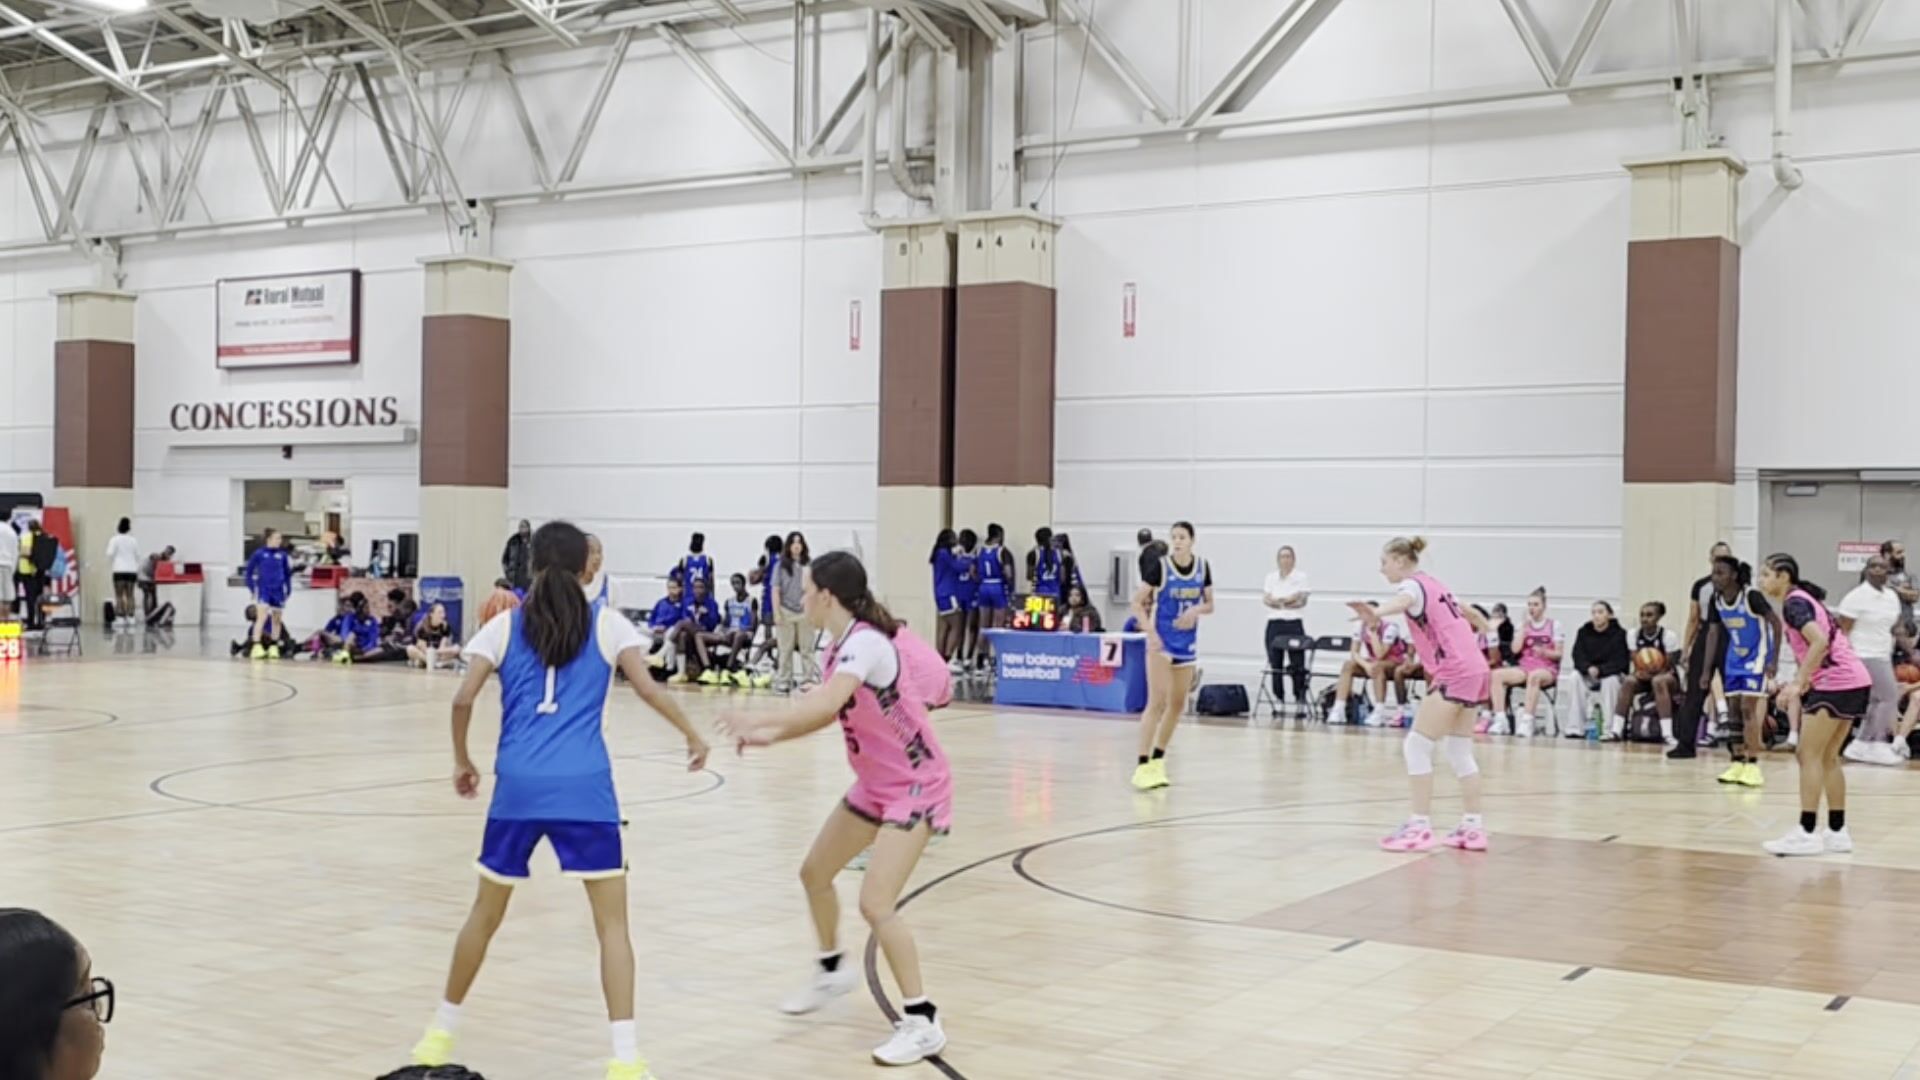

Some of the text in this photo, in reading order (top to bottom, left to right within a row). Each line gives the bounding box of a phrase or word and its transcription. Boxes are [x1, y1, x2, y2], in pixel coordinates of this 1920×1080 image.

[170, 396, 398, 432] CONCESSIONS
[1002, 652, 1076, 669] new balance
[1104, 642, 1118, 662] 7
[1002, 665, 1060, 680] basketball
[535, 664, 559, 715] 1
